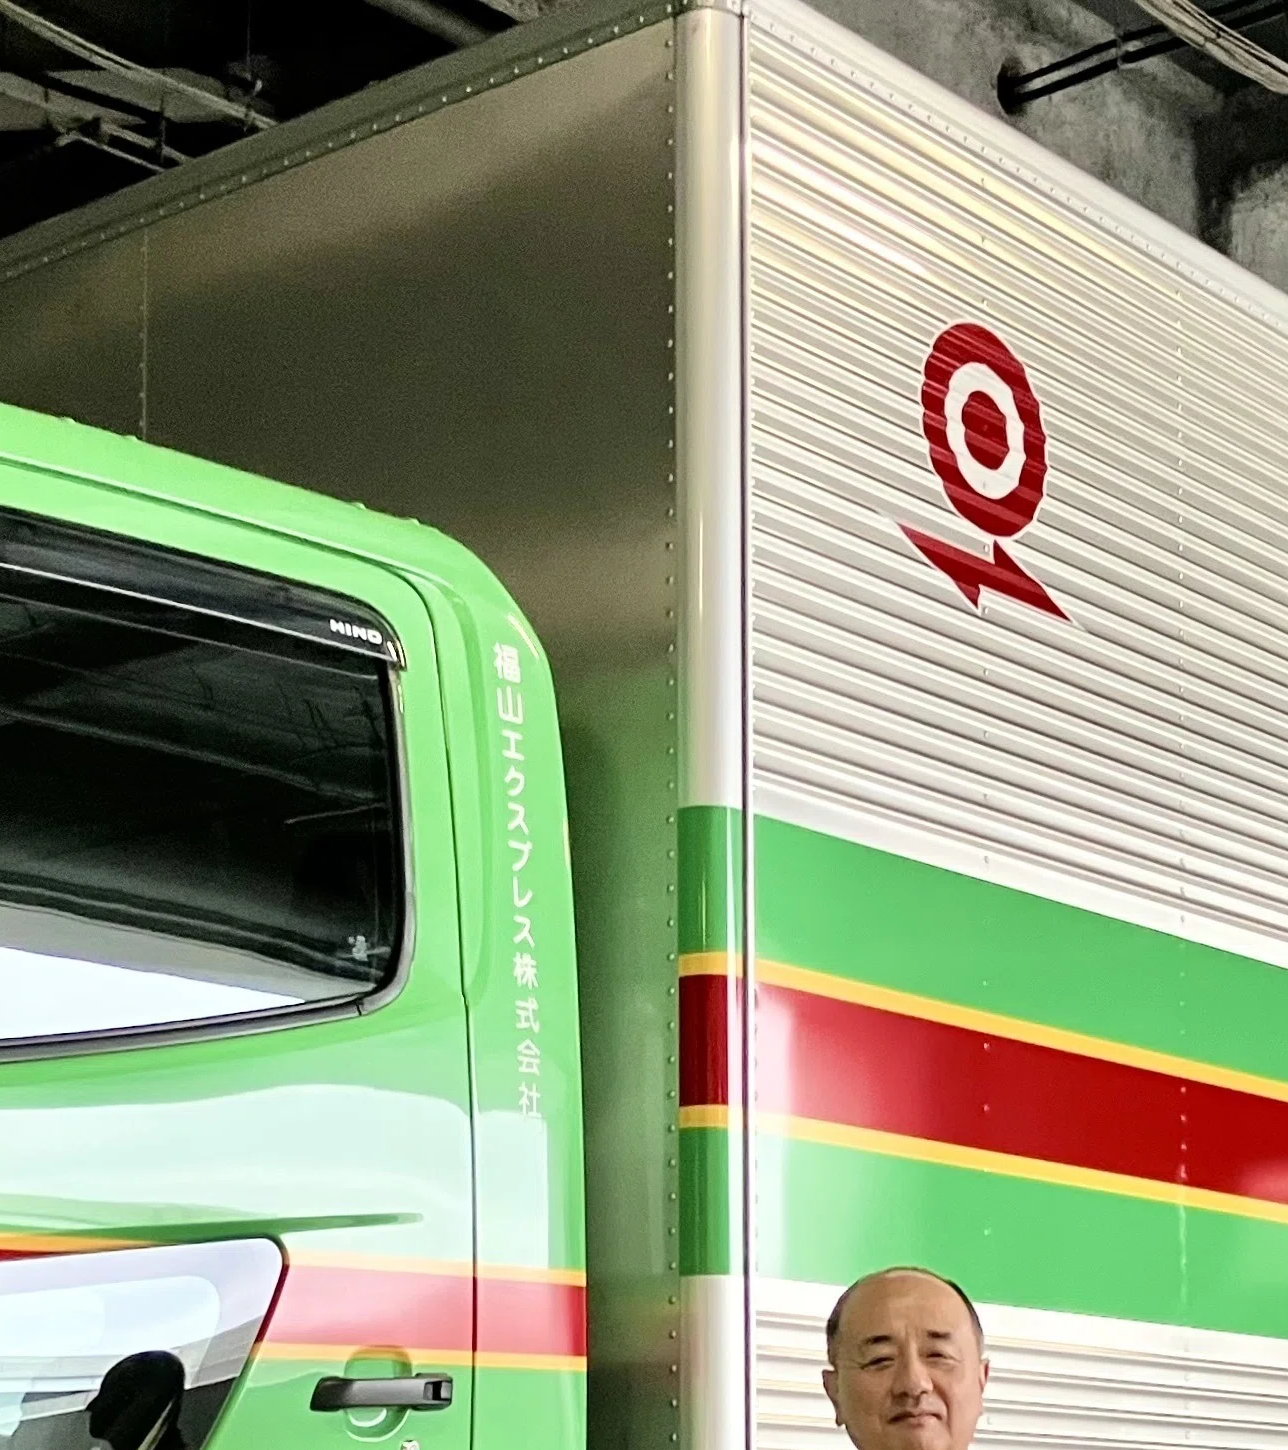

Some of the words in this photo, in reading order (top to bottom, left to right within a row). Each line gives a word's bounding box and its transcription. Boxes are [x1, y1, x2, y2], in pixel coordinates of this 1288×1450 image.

[329, 618, 383, 645] HINO
[493, 643, 542, 1118] 福山エクスプレス株式会社
